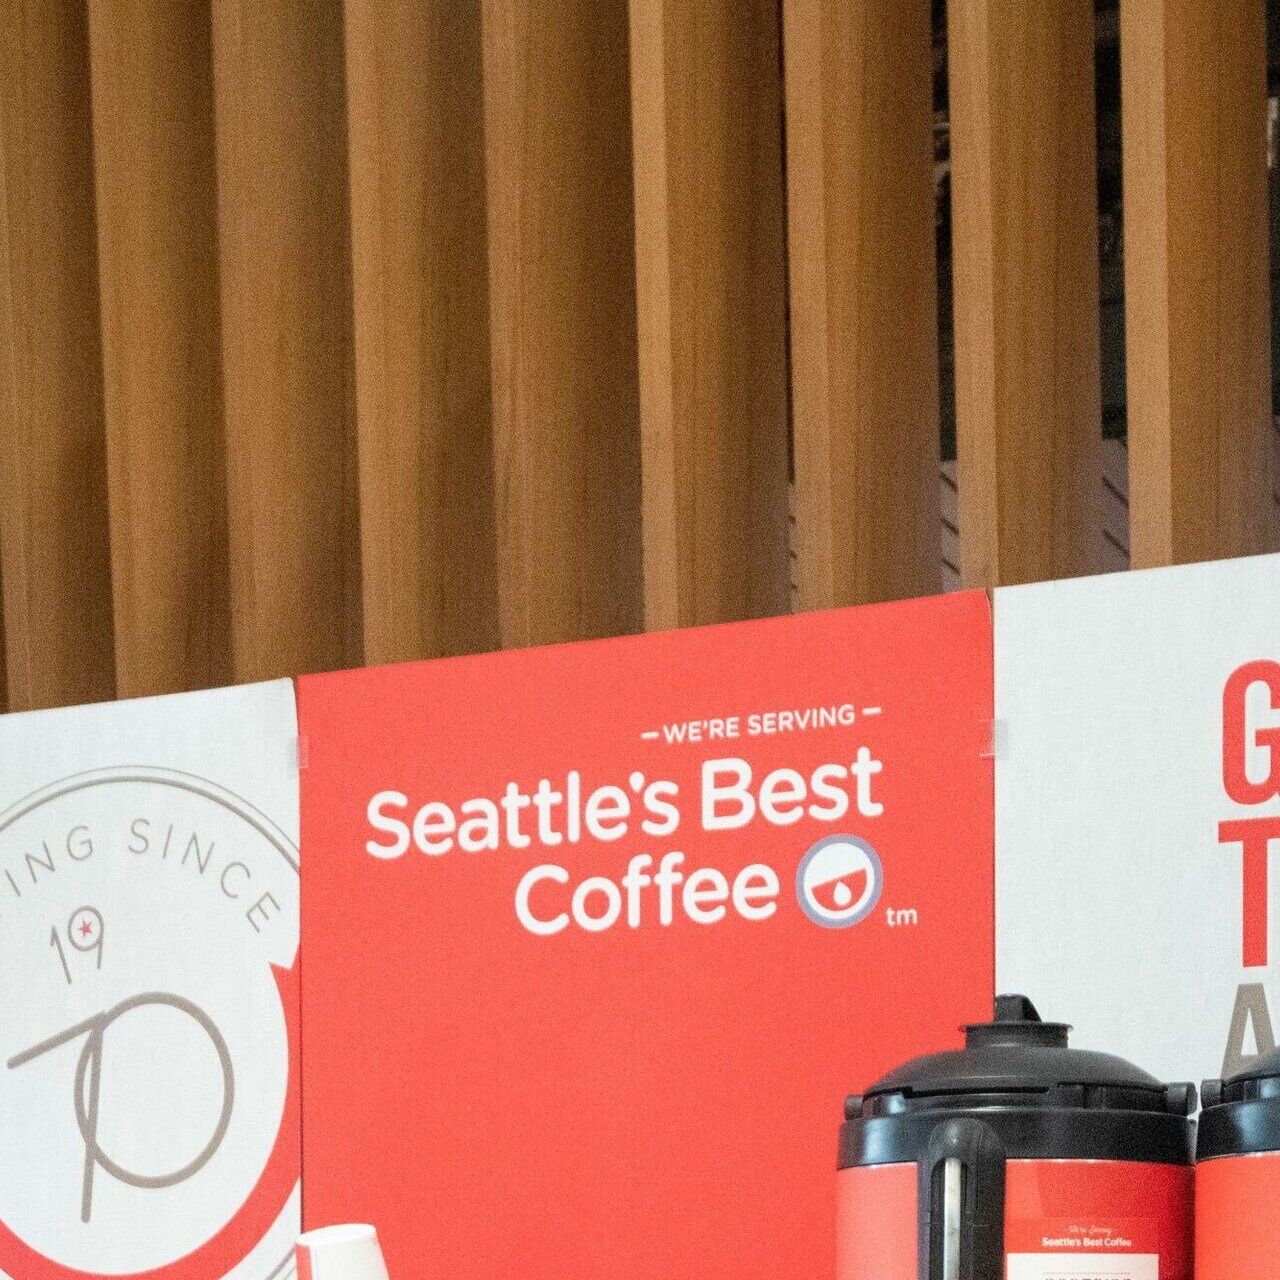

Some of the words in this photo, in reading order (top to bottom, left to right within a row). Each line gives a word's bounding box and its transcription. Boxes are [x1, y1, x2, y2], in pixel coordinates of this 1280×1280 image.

[663, 716, 741, 745] WE'RE
[747, 702, 856, 736] SERVING
[366, 769, 680, 860] Seattle's
[700, 745, 884, 831] Best
[127, 817, 281, 935] SINCE
[515, 851, 780, 936] Coffee
[49, 905, 105, 986] 19
[1041, 1237, 1081, 1247] Seattle's
[1083, 1237, 1104, 1247] Best
[1104, 1237, 1132, 1247] Coffee
